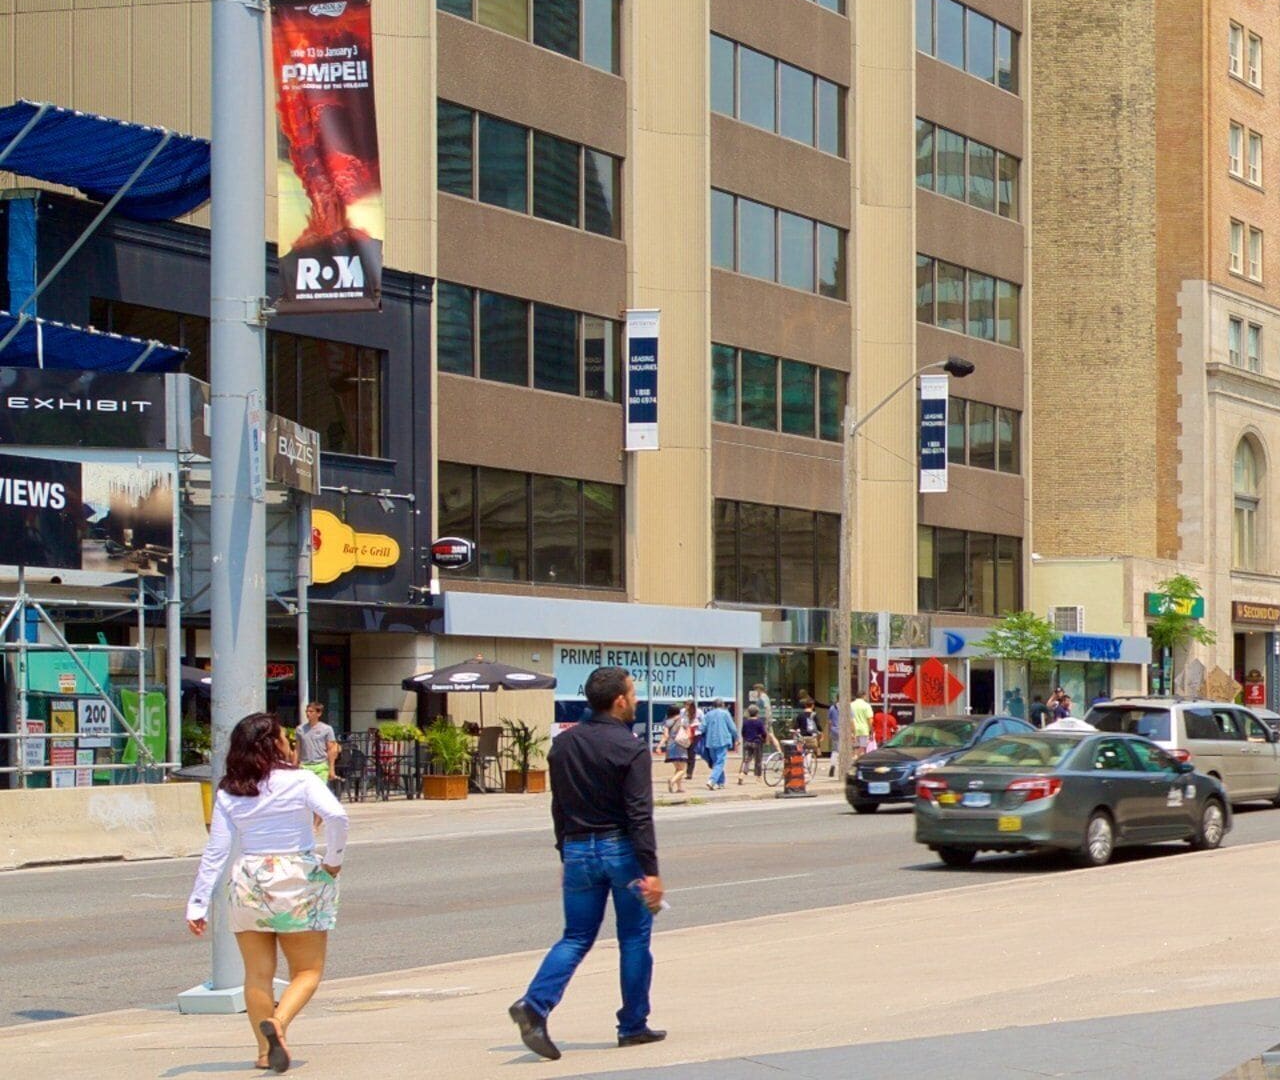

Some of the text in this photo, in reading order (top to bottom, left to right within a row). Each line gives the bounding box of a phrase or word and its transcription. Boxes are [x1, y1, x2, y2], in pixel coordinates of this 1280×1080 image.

[307, 48, 315, 57] 13
[316, 48, 323, 57] to
[325, 47, 352, 58] January
[353, 45, 358, 55] 3
[282, 61, 368, 83] POMPEII
[296, 255, 364, 290] ROM
[8, 397, 152, 412] EXHIBIT
[279, 436, 314, 465] BAZIS
[343, 543, 391, 557] Bar & Grill
[1243, 604, 1280, 620] SECOND CUP
[560, 648, 715, 668] PRIME RETAIL LOCATON
[652, 670, 663, 683] SQ
[666, 670, 676, 682] FT
[653, 685, 715, 697] MMEDIAELY
[85, 705, 106, 724] 200
